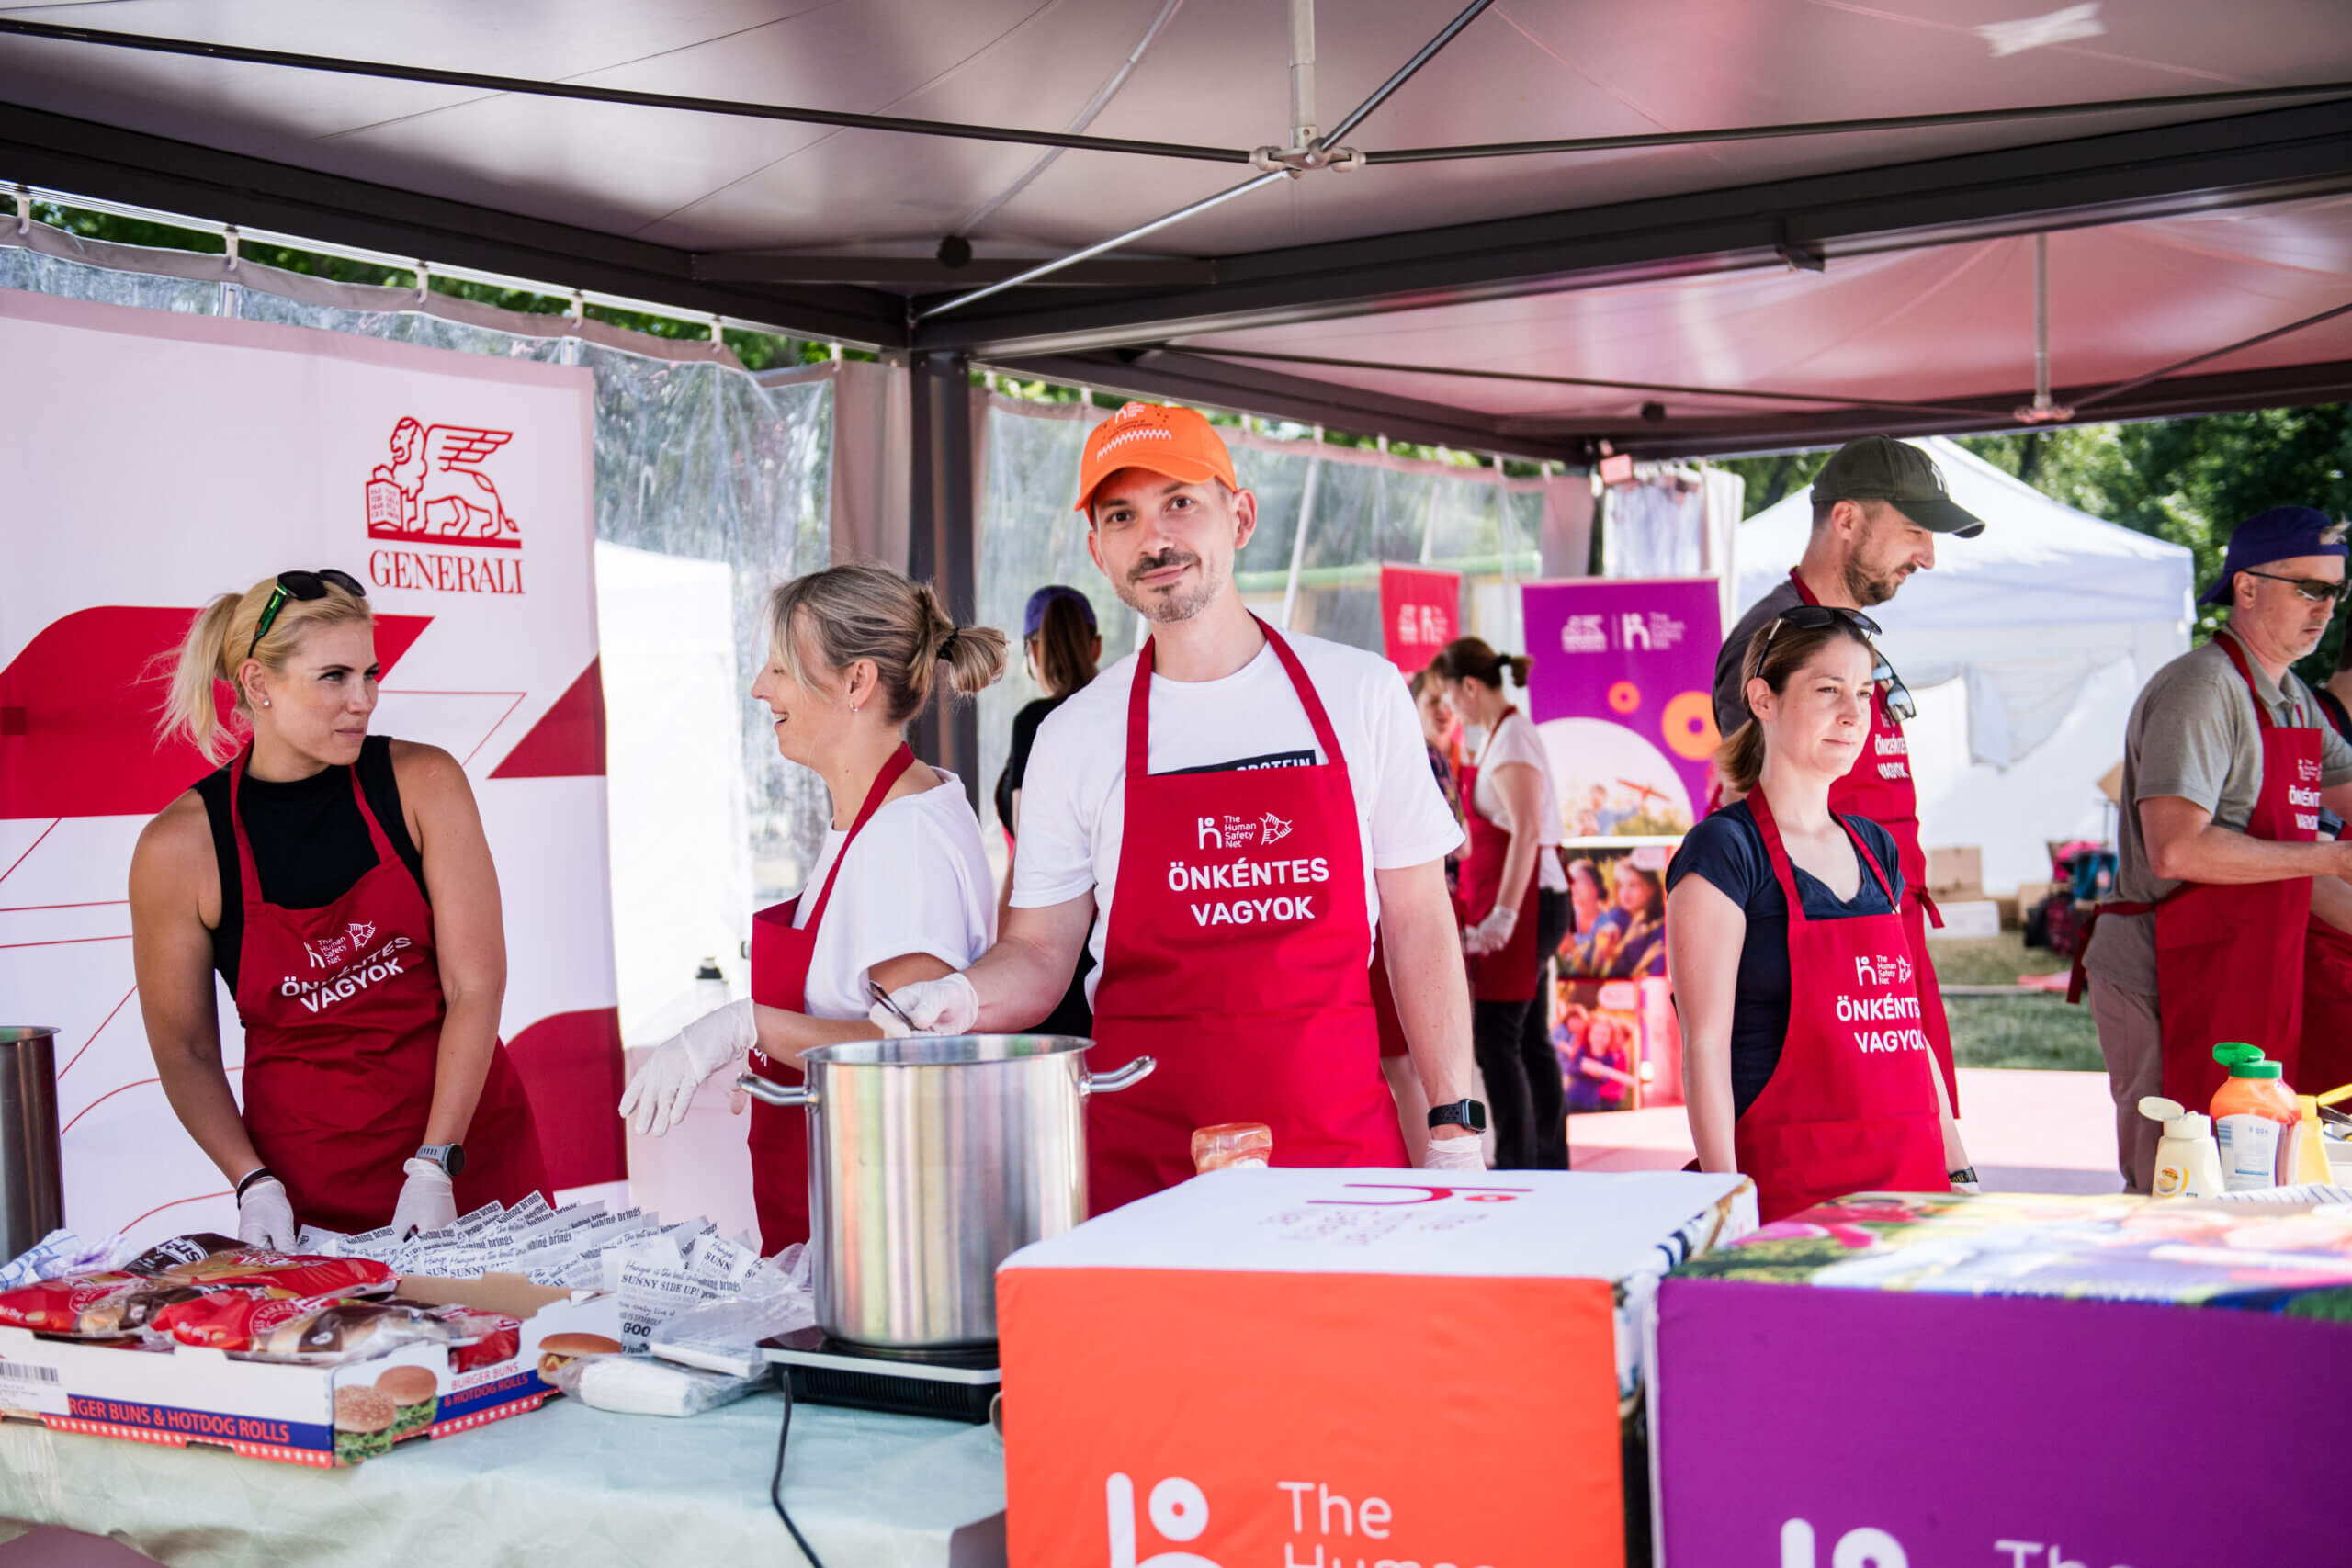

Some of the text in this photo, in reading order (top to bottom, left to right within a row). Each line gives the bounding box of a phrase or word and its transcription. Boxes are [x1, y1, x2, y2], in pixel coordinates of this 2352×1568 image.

[369, 549, 526, 595] GENERALI
[1224, 816, 1240, 824] The
[1225, 823, 1257, 831] Human
[1225, 831, 1254, 840] Safety
[1226, 840, 1242, 848] Net
[1168, 857, 1330, 892] ÖNKÉNTES
[1191, 896, 1316, 927] VAGYOK
[327, 955, 342, 965] Net
[300, 957, 405, 1013] VAGYOK
[620, 1274, 659, 1290] SUNNY
[660, 1281, 683, 1293] SIDE
[109, 1404, 151, 1425] BUNS
[153, 1408, 166, 1427] &
[167, 1410, 236, 1436] HOTDOG
[238, 1420, 290, 1443] ROLLS
[1277, 1481, 1392, 1539] The
